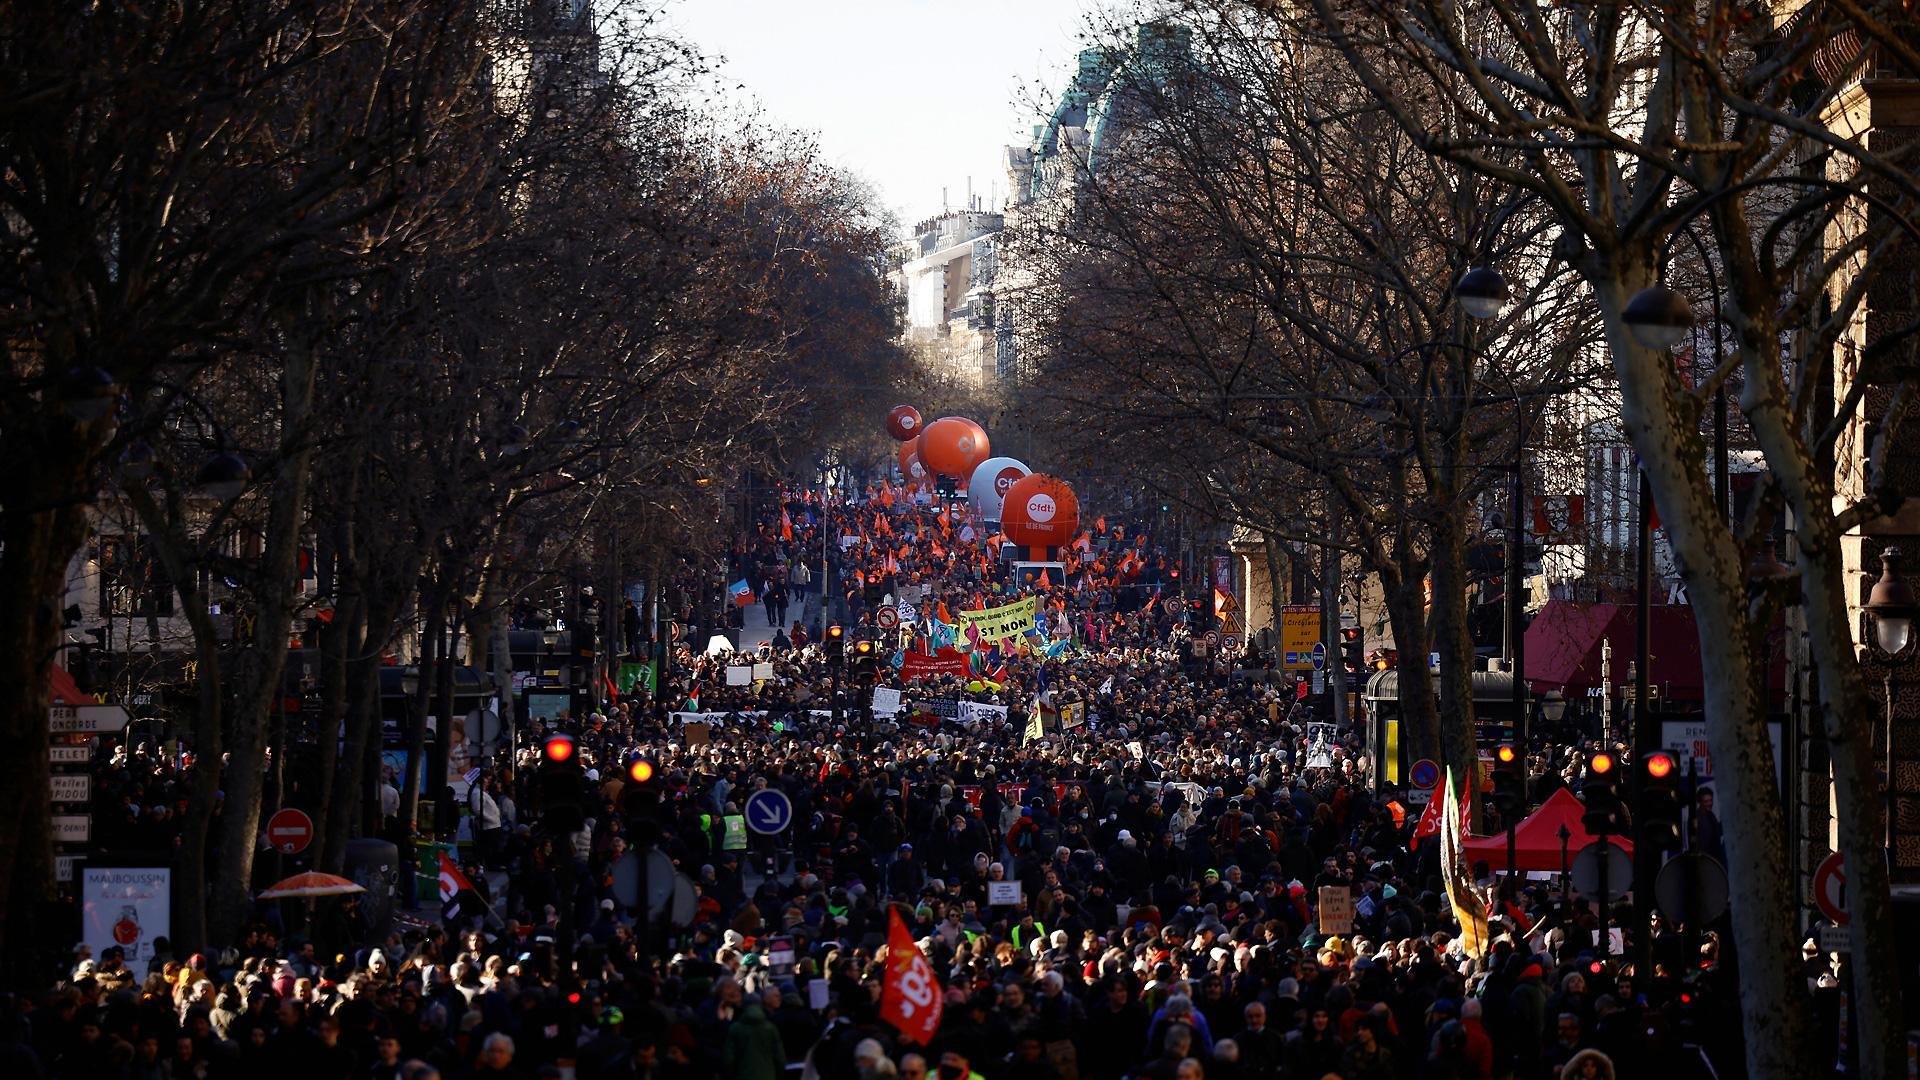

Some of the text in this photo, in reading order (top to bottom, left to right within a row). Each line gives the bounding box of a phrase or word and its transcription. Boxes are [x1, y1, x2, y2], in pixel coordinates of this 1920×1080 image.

[1029, 502, 1054, 513] Cfdt:
[1000, 618, 1028, 634] NON
[1225, 638, 1235, 646] 30
[1587, 687, 1605, 697] KF
[51, 720, 97, 730] ONCORDE
[51, 789, 87, 799] PIDOU
[89, 873, 166, 884] MAUBOUSSIN
